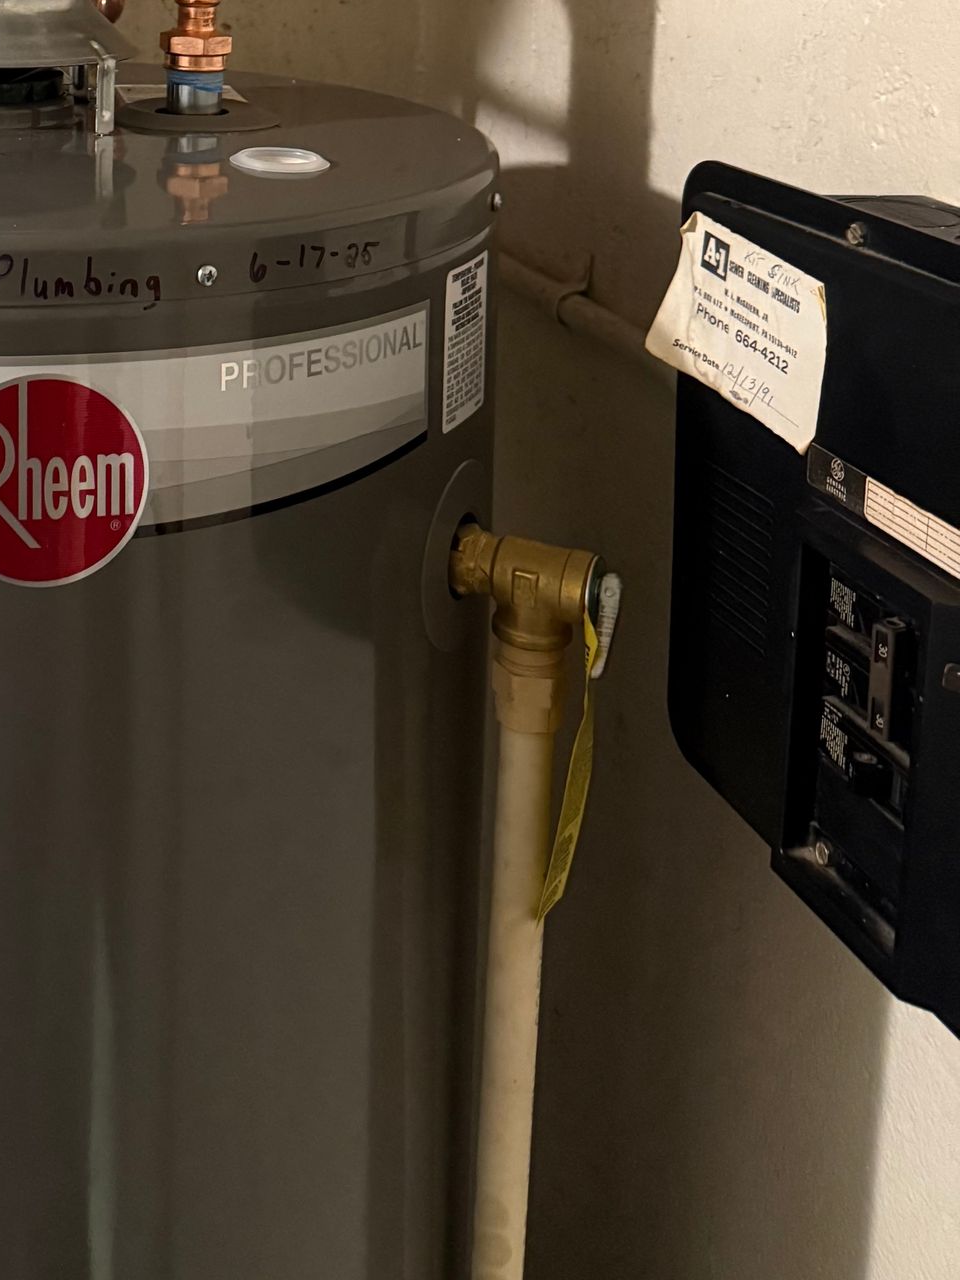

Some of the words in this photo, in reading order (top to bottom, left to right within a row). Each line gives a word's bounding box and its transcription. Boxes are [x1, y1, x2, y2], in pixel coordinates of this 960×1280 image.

[249, 241, 380, 283] 6-17-25
[220, 322, 423, 392] PROFESSIONAL
[672, 338, 701, 359] Service
[702, 353, 720, 371] Date
[696, 302, 730, 334] Phone
[735, 329, 789, 375] 664-4212
